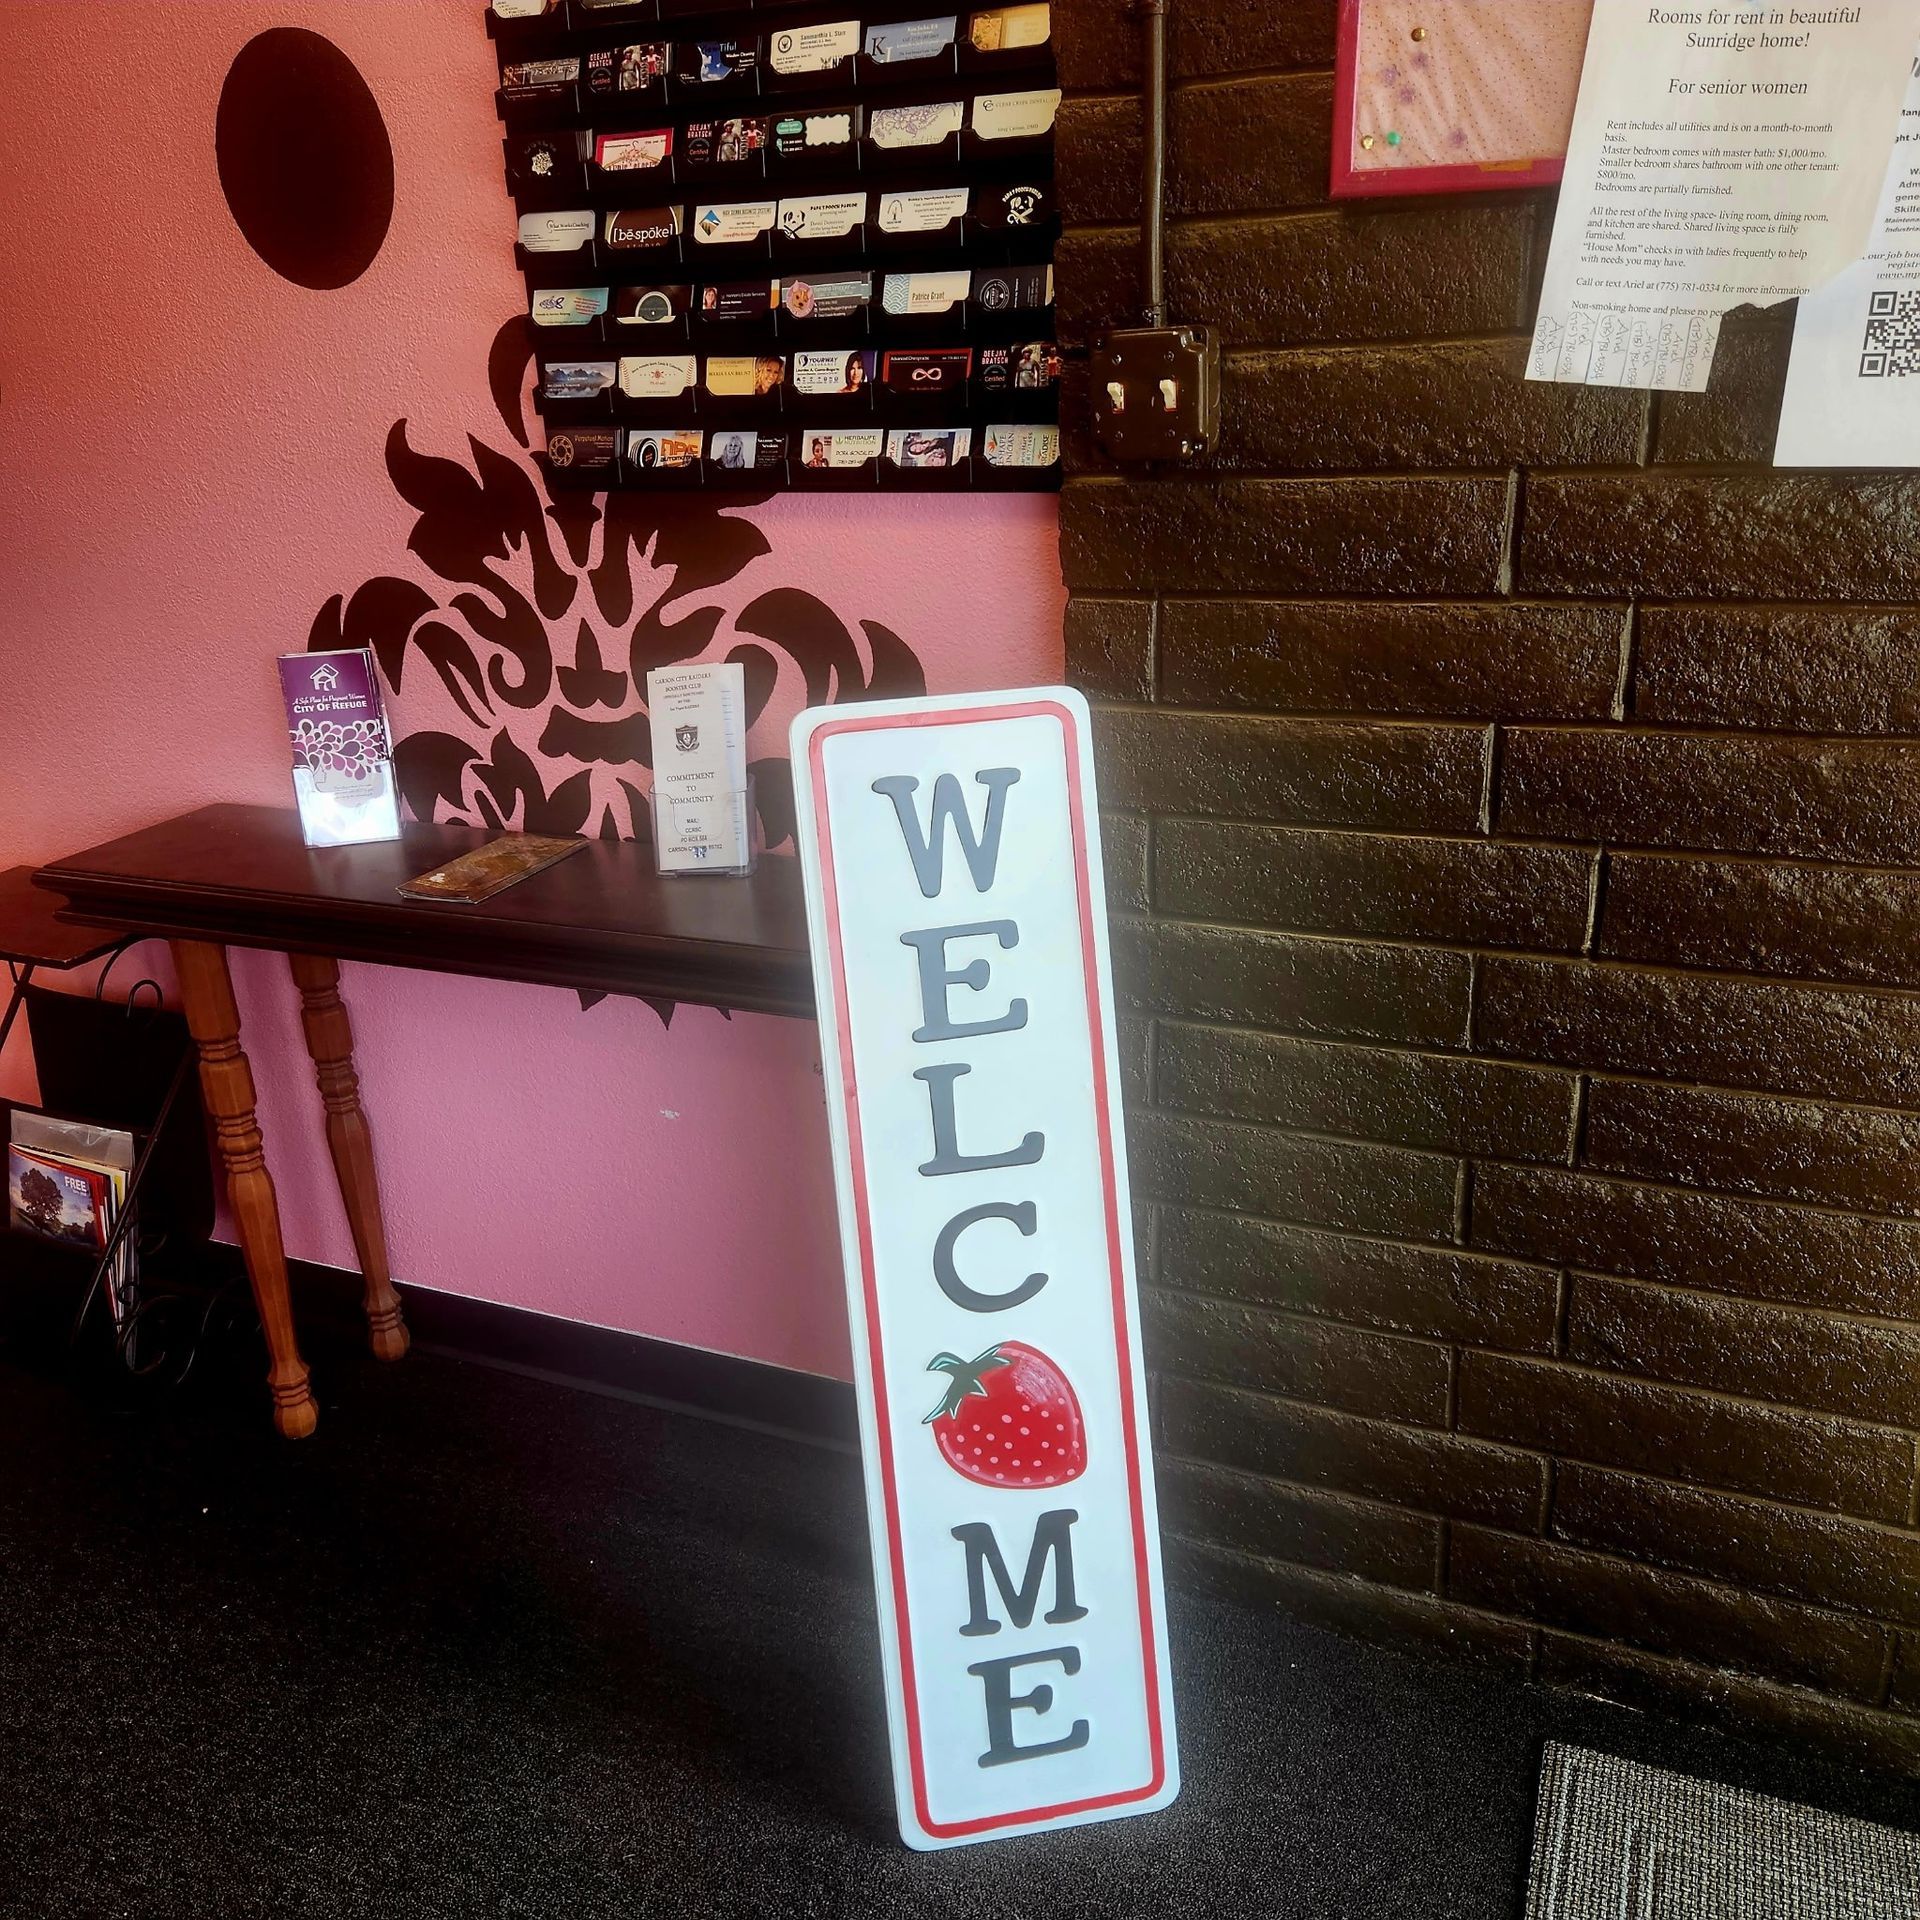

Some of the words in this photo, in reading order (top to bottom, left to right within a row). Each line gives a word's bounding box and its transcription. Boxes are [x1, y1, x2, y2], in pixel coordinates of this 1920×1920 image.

[1648, 8, 1702, 24] Rooms
[1707, 8, 1730, 25] for
[1734, 12, 1764, 25] rent
[1770, 8, 1784, 24] in
[1789, 7, 1861, 24] beautiful
[1686, 32, 1755, 52] Sunridge
[1760, 32, 1810, 48] home!
[1668, 78, 1695, 94] For
[1699, 79, 1747, 94] senior
[1752, 82, 1808, 94] women
[1607, 120, 1626, 130] Rent
[1629, 121, 1663, 131] includes
[1666, 122, 1677, 131] all
[1680, 123, 1711, 132] utilities
[1713, 123, 1729, 132] and
[1731, 123, 1738, 132] is
[1761, 123, 1833, 132] month-to-month
[1604, 133, 1628, 142] basis.
[1602, 145, 1631, 155] Master
[1633, 146, 1670, 156] bedroom
[1702, 148, 1720, 157] with
[1723, 149, 1752, 157] master
[1600, 158, 1632, 167] Smaller
[1634, 159, 1671, 168] bedroom
[1673, 160, 1700, 169] shares
[1702, 160, 1742, 170] bathroom
[1745, 161, 1764, 170] with
[1766, 163, 1782, 171] one
[1784, 161, 1807, 171] other
[1595, 182, 1637, 192] Bedrooms
[1639, 185, 1652, 193] are
[1654, 185, 1690, 195] partially
[1691, 185, 1733, 195] furnished.
[1590, 206, 1603, 215] All
[1605, 207, 1618, 216] the
[1620, 208, 1636, 217] rest
[1637, 208, 1649, 217] of
[1649, 208, 1661, 217] the
[1664, 209, 1688, 220] living
[1720, 210, 1744, 222] living
[1774, 212, 1801, 223] dining
[1587, 219, 1602, 227] and
[1605, 220, 1634, 229] kitchen
[1652, 222, 1681, 230] shared.
[1684, 222, 1713, 231] Shared
[1715, 223, 1739, 234] living
[1742, 225, 1766, 234] space
[1768, 224, 1775, 233] is
[1778, 225, 1798, 235] fully
[1585, 230, 1625, 240] furnished.
[1644, 245, 1673, 254] checks
[1675, 246, 1683, 255] in
[1686, 247, 1704, 255] with
[1706, 247, 1730, 256] ladies
[1733, 248, 1776, 259] frequently
[1778, 250, 1787, 258] to
[1788, 249, 1807, 260] help
[1581, 254, 1598, 263] with
[1600, 256, 1624, 264] needs
[1625, 258, 1642, 266] you
[1644, 259, 1661, 267] may
[1664, 258, 1686, 267] have.
[1576, 277, 1593, 286] Call
[1606, 280, 1621, 288] text
[1623, 280, 1645, 289] Ariel
[1656, 281, 1679, 291] (775)
[1681, 283, 1720, 292] 781-0334
[1722, 284, 1734, 293] for
[1736, 286, 1758, 294] more
[1760, 285, 1810, 295] information
[912, 293, 930, 301] Patrice
[931, 292, 945, 300] Grant
[1571, 301, 1626, 313] Non-smoking
[1628, 304, 1651, 313] home
[1653, 306, 1668, 314] and
[1670, 306, 1696, 316] please
[983, 350, 1007, 358] DEEJAY
[655, 677, 675, 685] CARSON
[332, 700, 368, 710] REFUGE
[667, 772, 714, 782] COMMITMENT
[670, 795, 714, 804] COMMUNITY
[64, 1175, 87, 1193] FREE
[871, 766, 1090, 1768] WELCME
